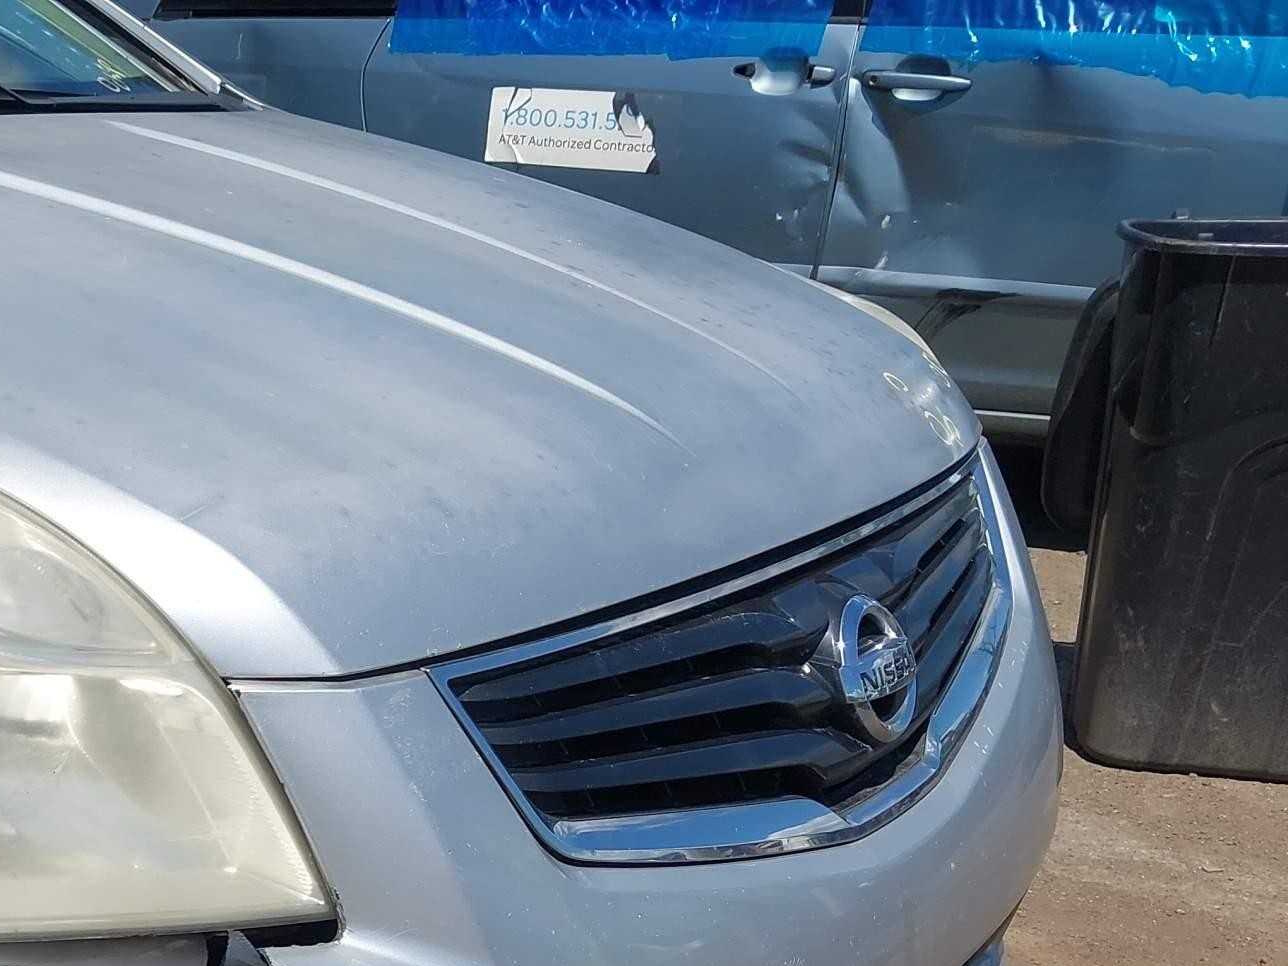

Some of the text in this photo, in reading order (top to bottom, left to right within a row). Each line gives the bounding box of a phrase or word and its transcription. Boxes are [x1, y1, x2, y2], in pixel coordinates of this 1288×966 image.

[501, 107, 623, 131] 1.800.531.5
[498, 134, 654, 153] AT&T Authorized Contracto
[859, 653, 914, 693] NISS
